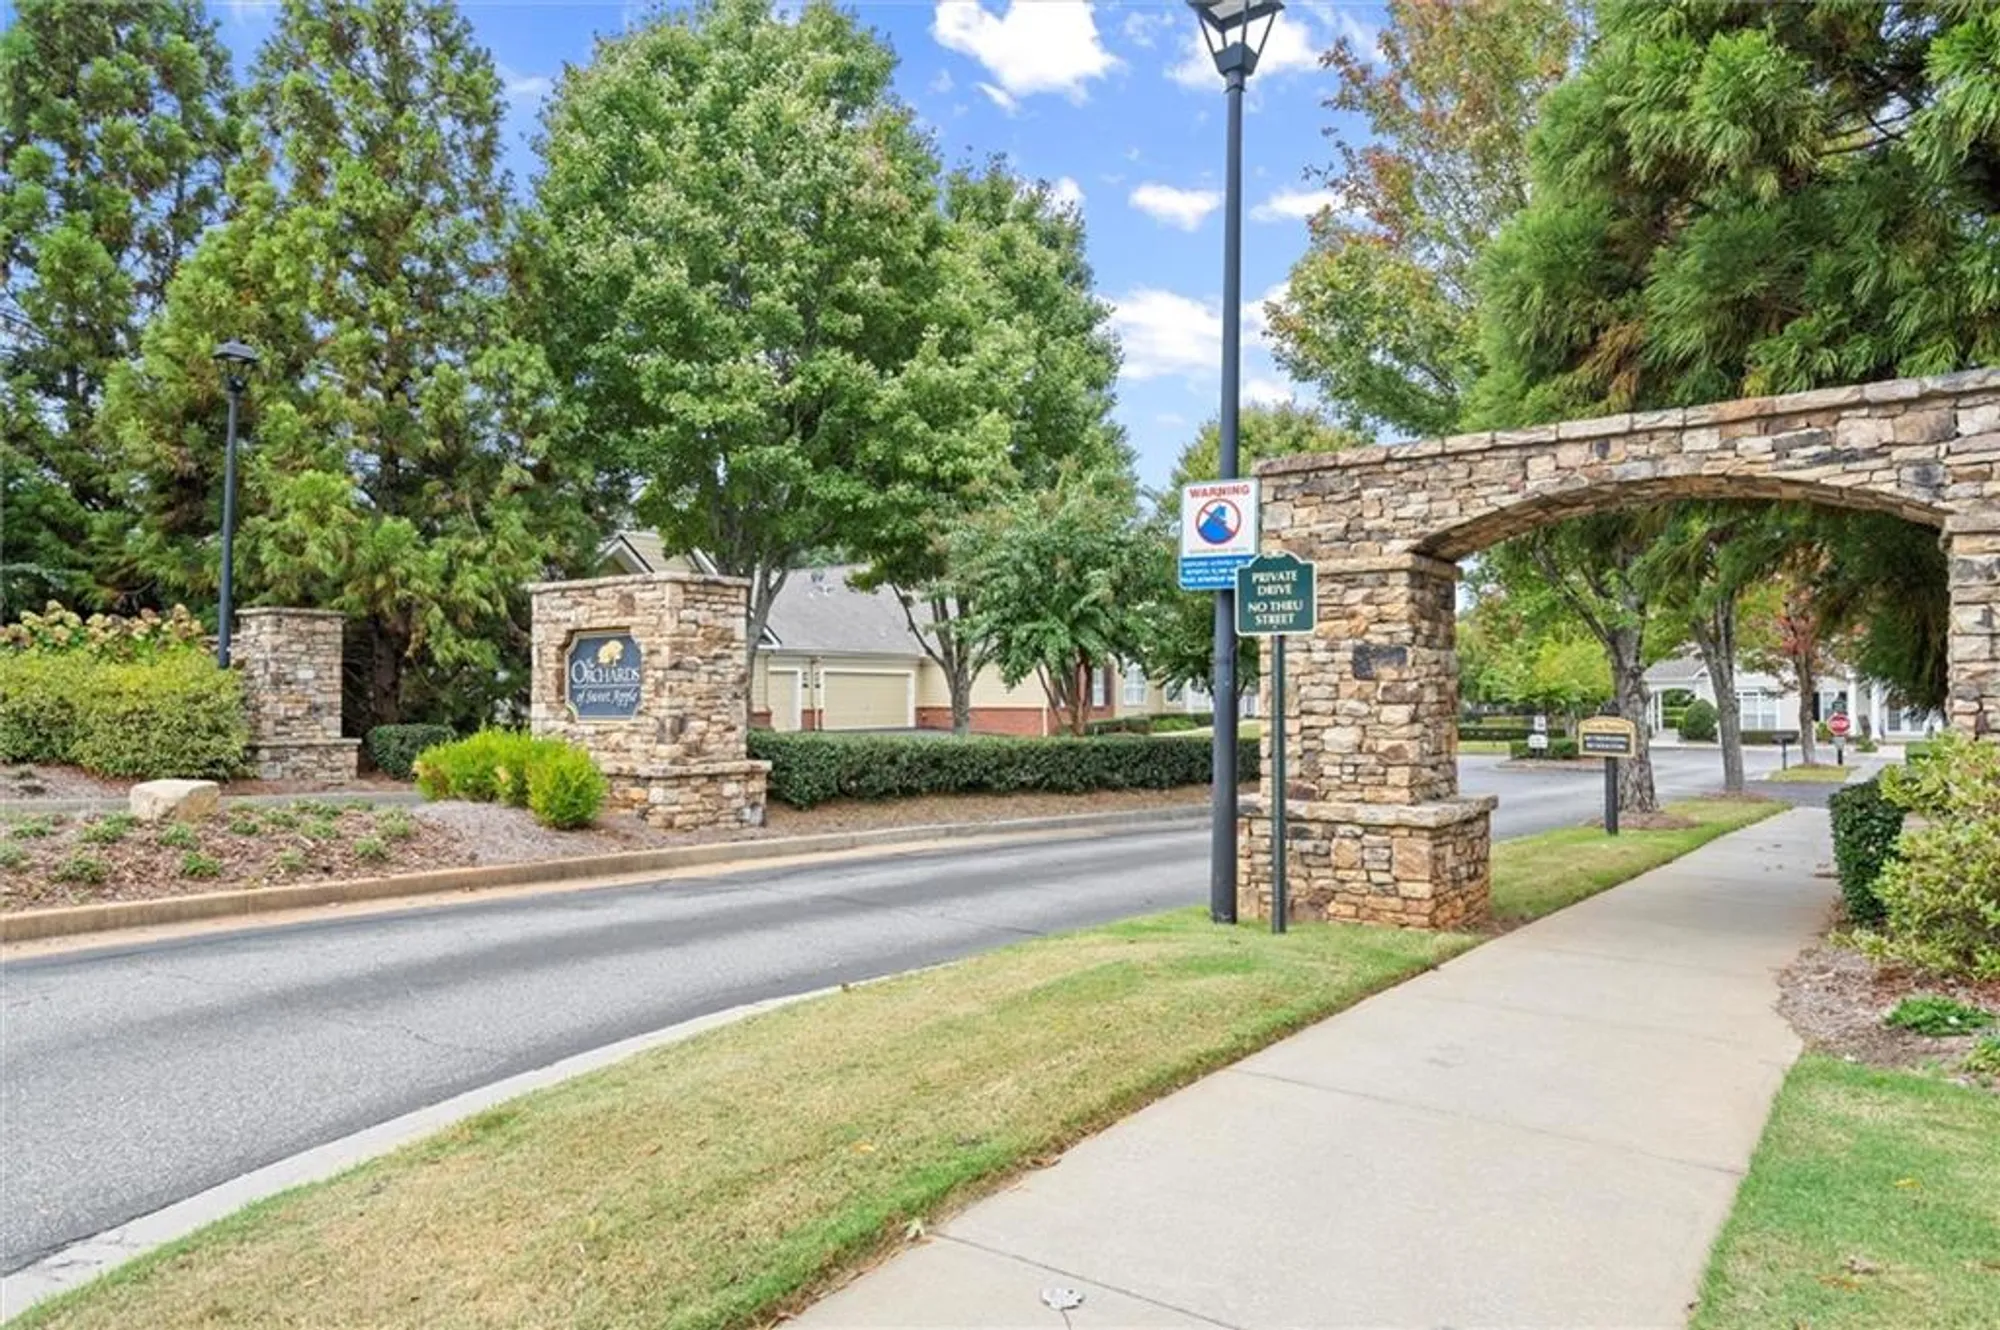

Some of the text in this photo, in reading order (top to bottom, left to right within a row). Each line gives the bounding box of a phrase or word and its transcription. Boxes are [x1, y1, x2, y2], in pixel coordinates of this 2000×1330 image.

[1190, 485, 1250, 498] WARNING
[1252, 570, 1298, 583] PRIVATE
[1257, 583, 1292, 596] DRIVE
[1247, 599, 1304, 613] NO THRU
[1255, 613, 1295, 626] STREET
[571, 660, 640, 683] ORCHARDS
